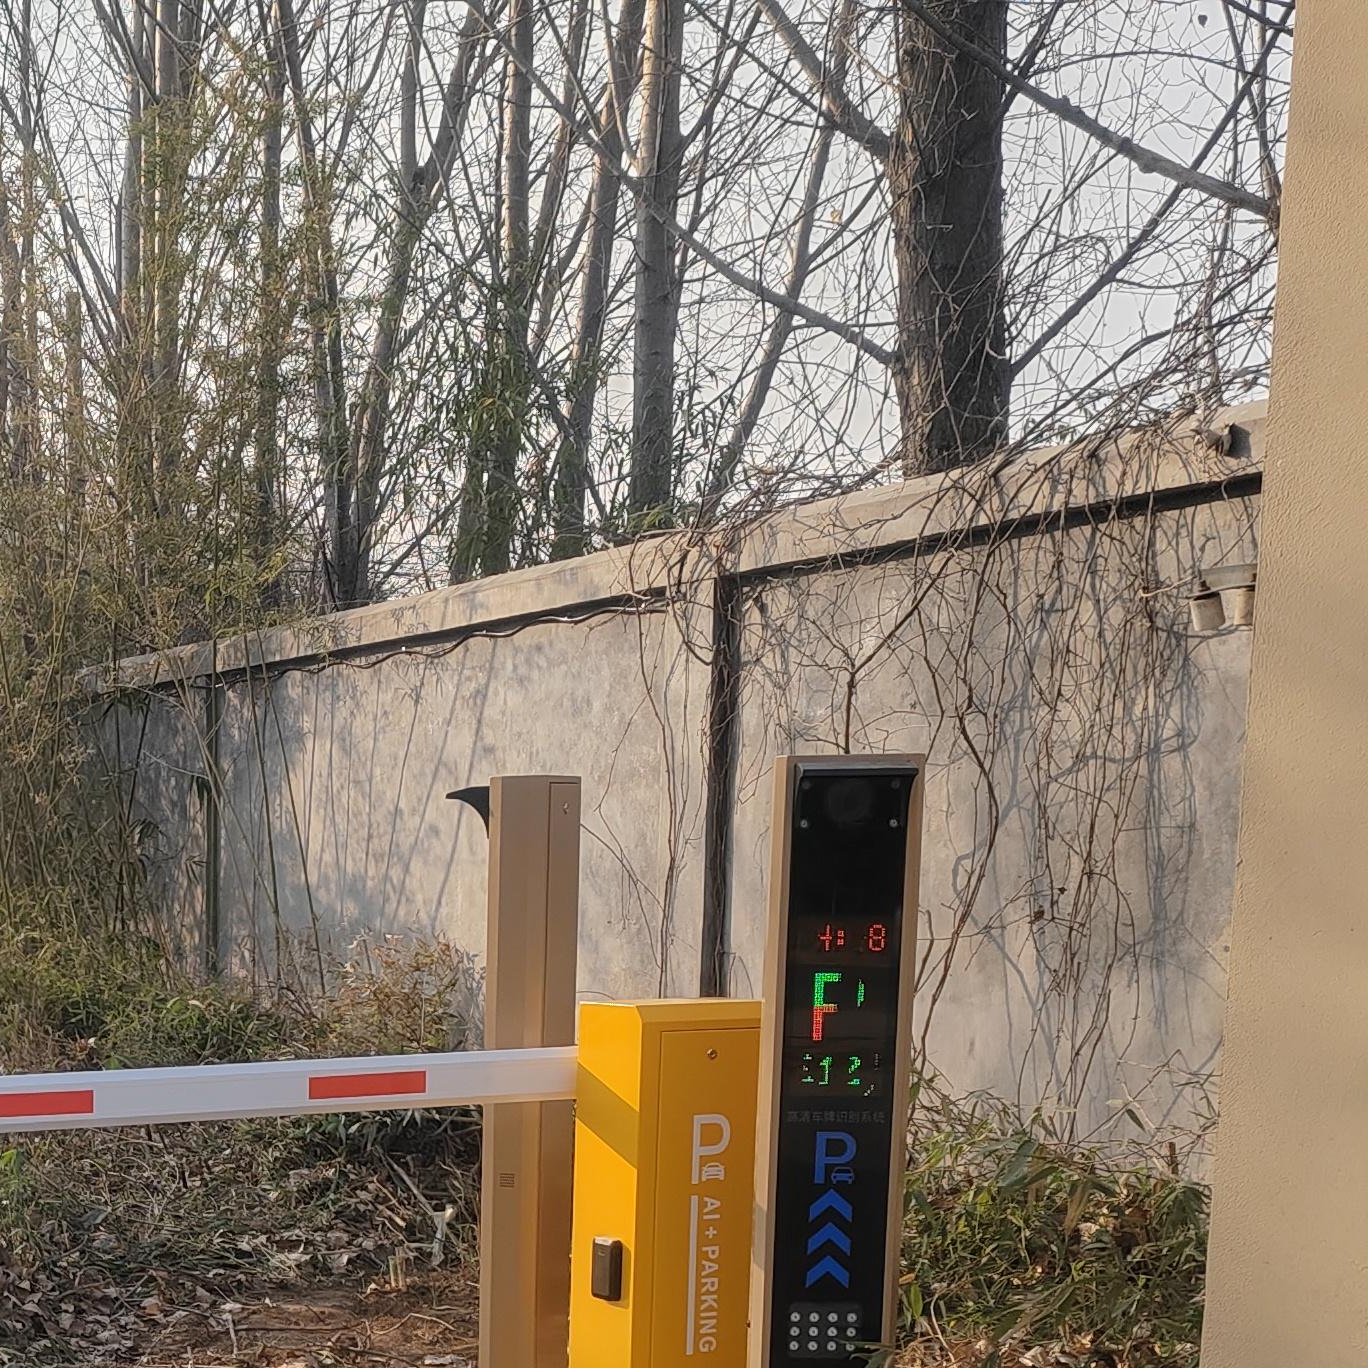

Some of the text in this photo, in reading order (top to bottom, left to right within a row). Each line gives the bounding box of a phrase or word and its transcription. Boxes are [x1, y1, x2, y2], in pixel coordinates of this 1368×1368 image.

[691, 1114, 731, 1185] P
[814, 1131, 857, 1184] P
[699, 1245, 721, 1353] PARKING
